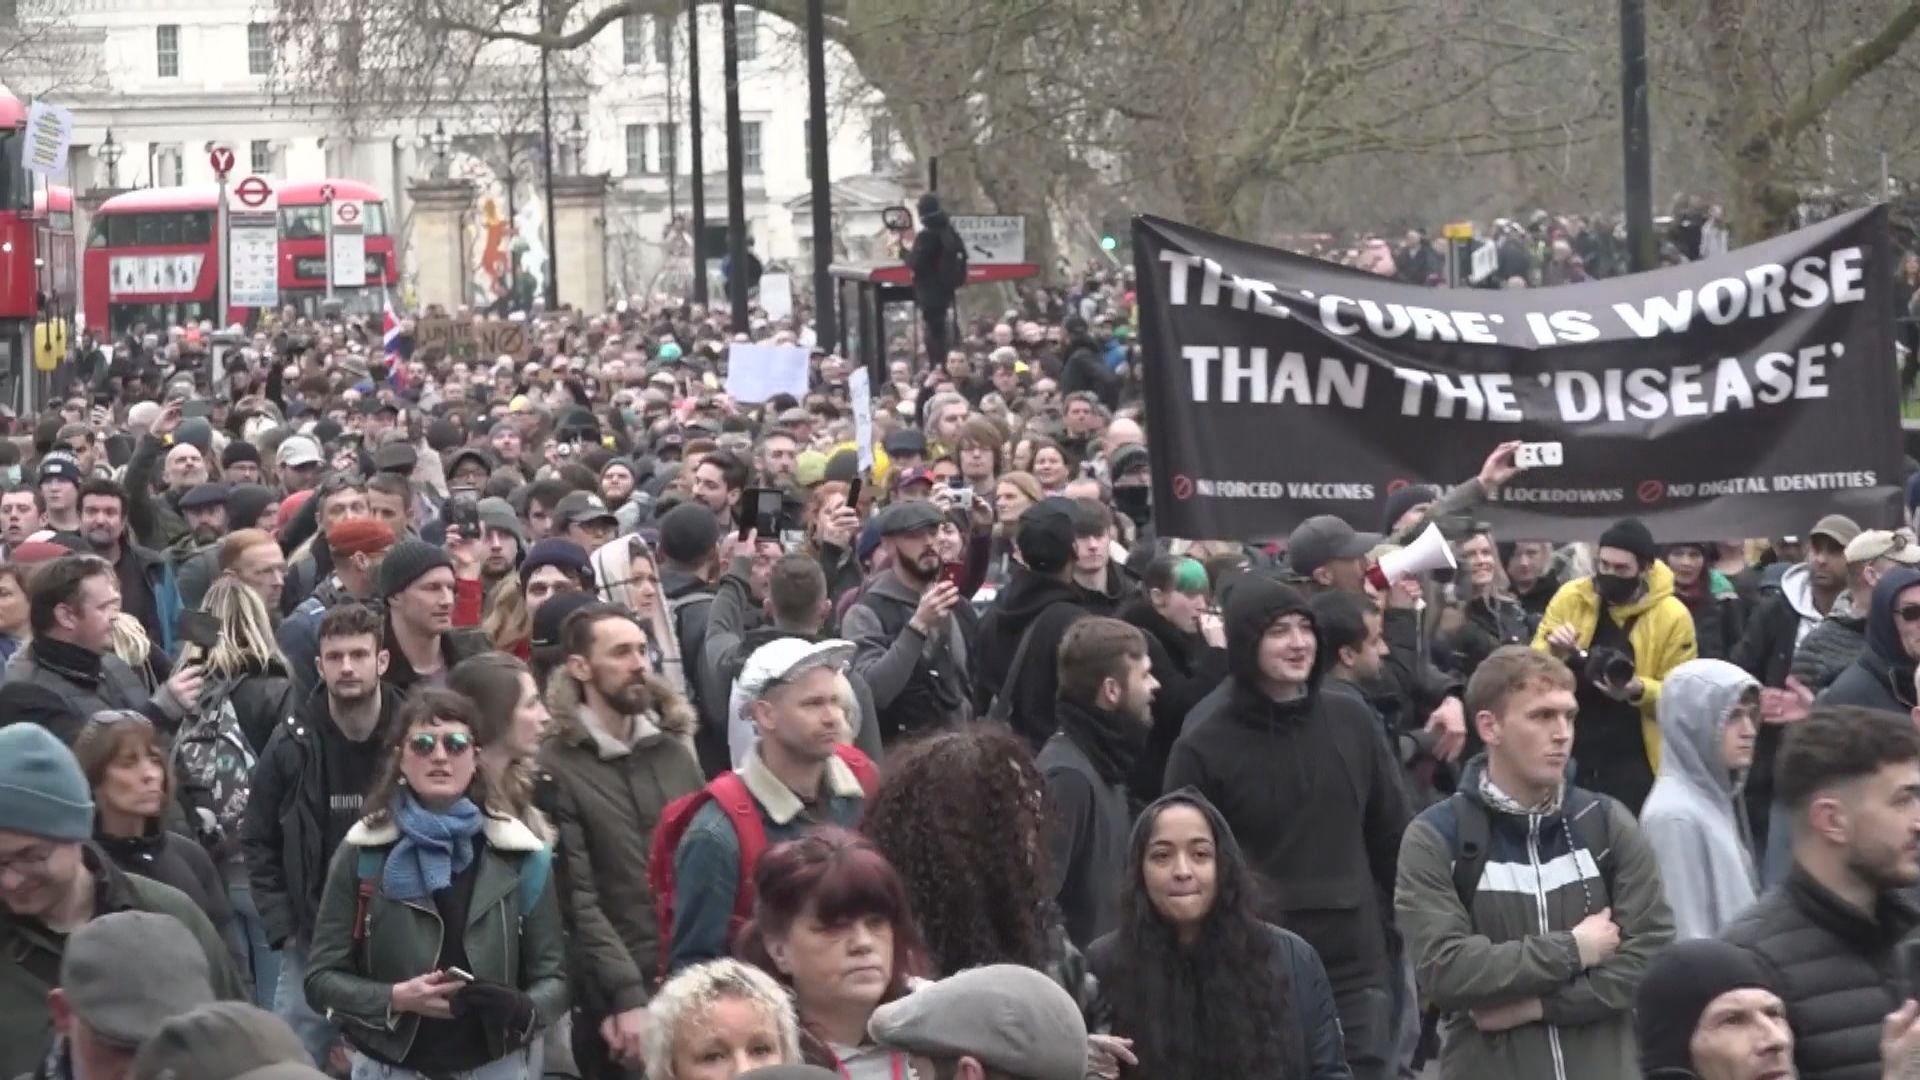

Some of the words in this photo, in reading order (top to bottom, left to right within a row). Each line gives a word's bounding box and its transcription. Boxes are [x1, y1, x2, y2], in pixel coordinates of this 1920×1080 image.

[214, 150, 230, 170] Y
[1159, 249, 1290, 319] THE
[1526, 310, 1600, 345] IS
[1612, 247, 1866, 338] WORSE
[1182, 346, 1369, 409] THAN
[1394, 367, 1523, 423] THE
[1216, 481, 1283, 499] FORCED
[1287, 482, 1375, 500] VACCINES
[1503, 487, 1624, 503] LOCKDOWNS
[1667, 484, 1695, 497] NO
[1699, 477, 1770, 496] DIGITAL
[1773, 470, 1877, 491] IDENTITIES
